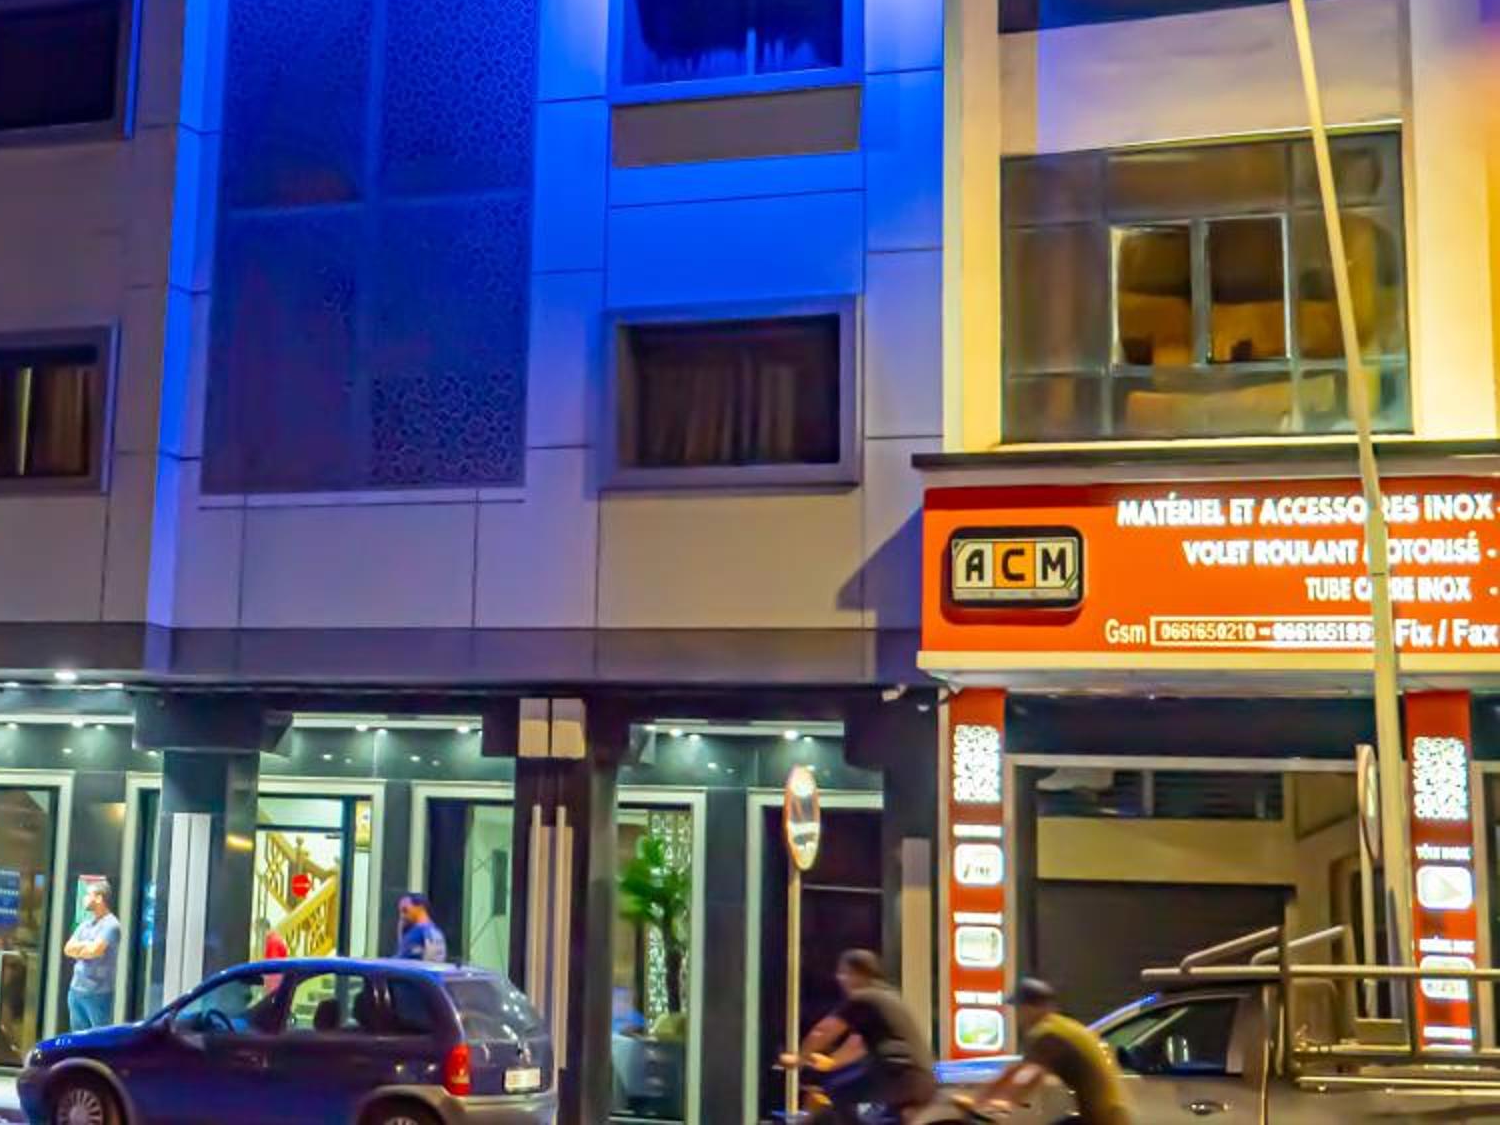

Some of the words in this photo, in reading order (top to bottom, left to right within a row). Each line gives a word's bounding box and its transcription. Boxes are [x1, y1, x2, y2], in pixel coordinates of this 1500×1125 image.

[1117, 491, 1226, 526] MATÉRIEL
[1229, 498, 1255, 525] ET
[1259, 495, 1419, 524] ACCESSORES
[1424, 493, 1495, 521] INOX
[965, 547, 1068, 582] ACM
[1182, 540, 1249, 565] VOLET
[1253, 539, 1358, 565] ROULANT
[1362, 530, 1481, 565] OTORISÉ
[1305, 577, 1351, 602] TUBE
[1417, 577, 1472, 602] INOX
[1105, 619, 1146, 644] Gsm
[1394, 618, 1433, 647] Fix
[1452, 618, 1500, 647] Fax
